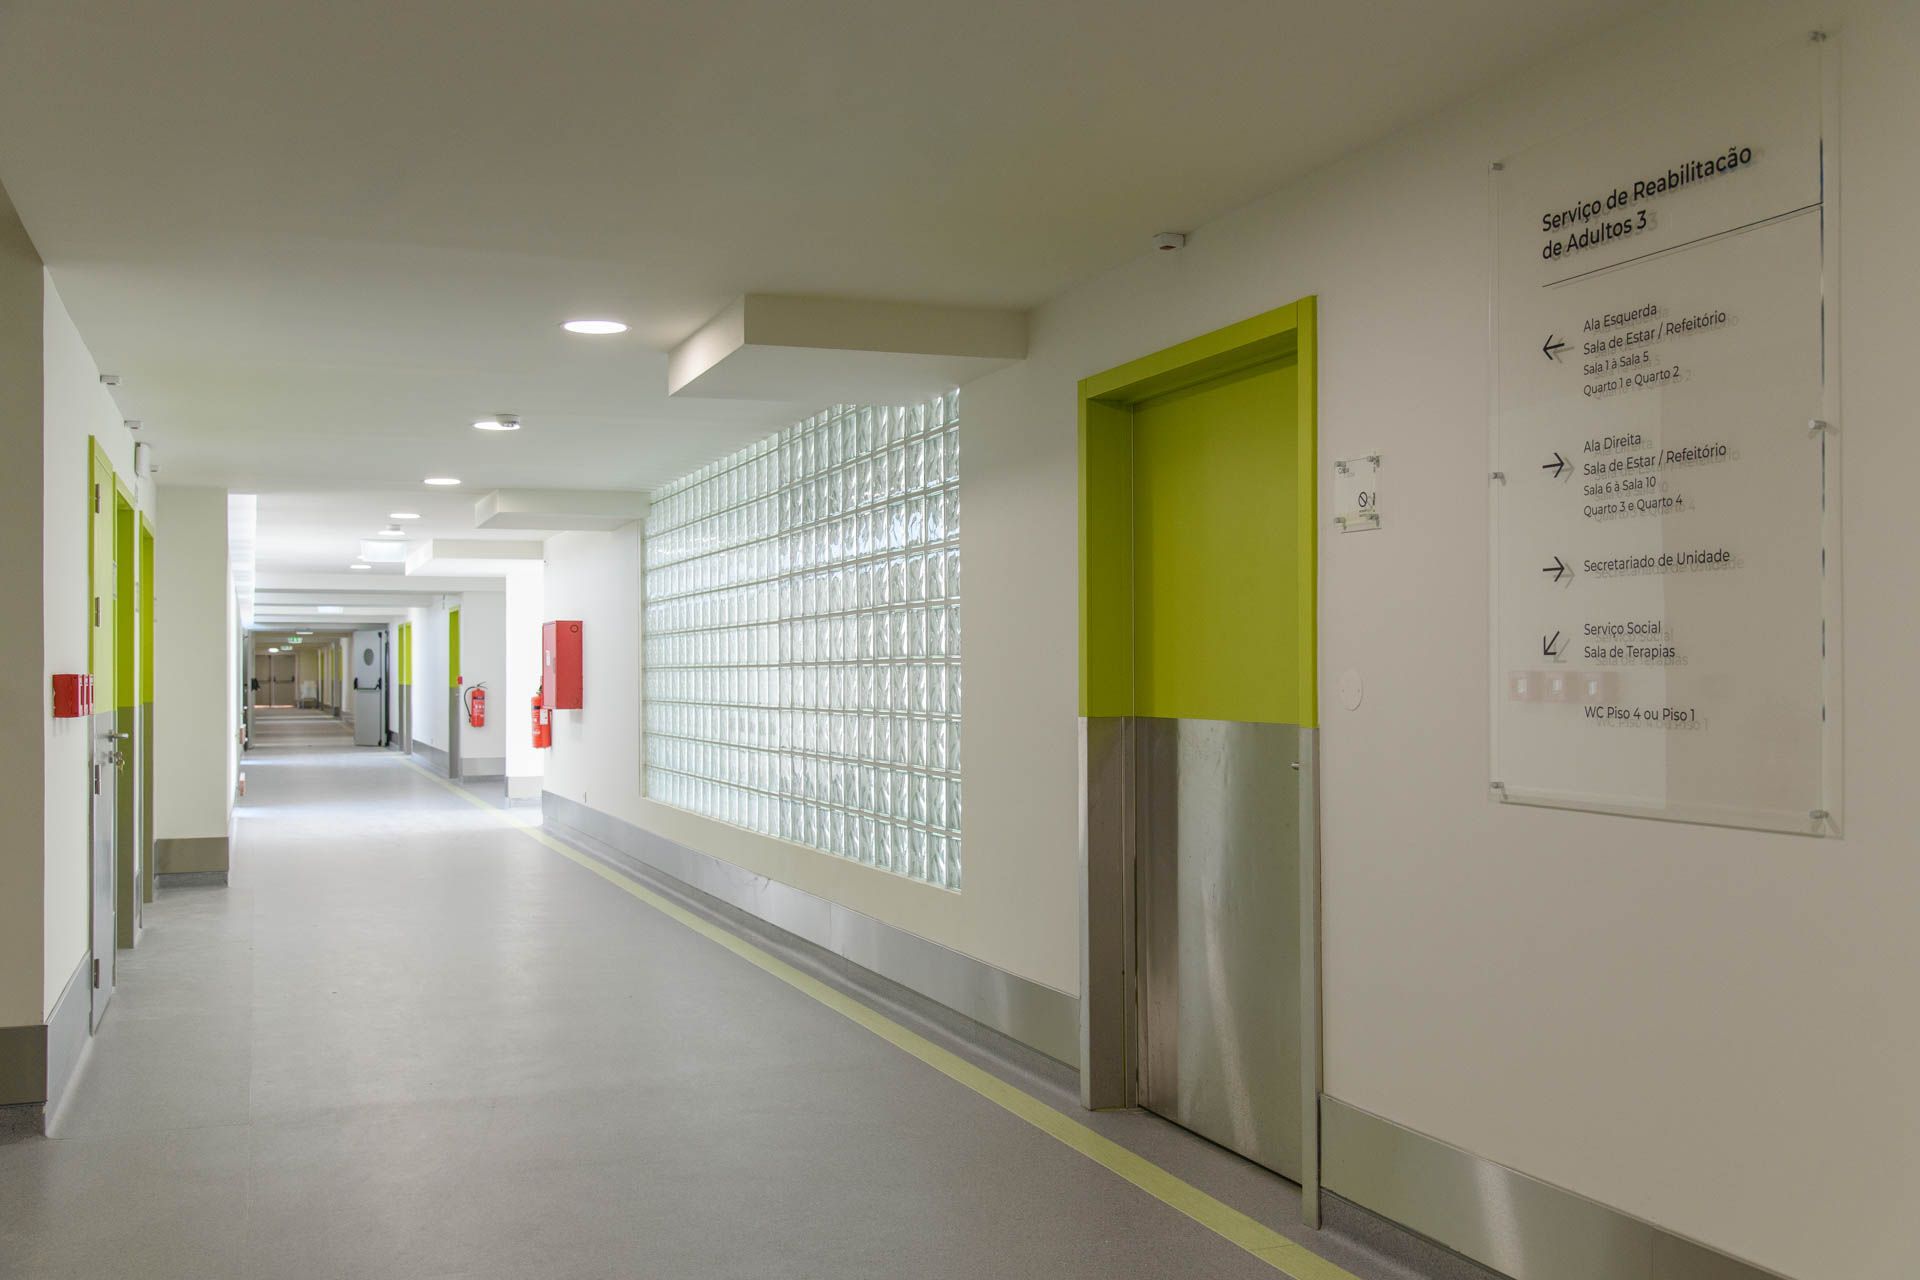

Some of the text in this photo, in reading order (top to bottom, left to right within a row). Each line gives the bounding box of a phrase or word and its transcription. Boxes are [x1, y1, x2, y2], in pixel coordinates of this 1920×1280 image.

[1542, 200, 1601, 232] Serviço
[1606, 189, 1628, 209] de
[1542, 209, 1648, 260] de Adultos 3
[1583, 303, 1657, 333] Ala Esquerda
[1583, 309, 1726, 356] Sala de Estar / Refeitório
[1583, 362, 1603, 376] Sala
[1605, 360, 1609, 371] 1
[1619, 353, 1640, 368] Sala
[1643, 351, 1649, 363] 5
[1583, 365, 1680, 397] Quarto 1 e Quarto 2
[1583, 433, 1642, 454] Ala Direita
[1583, 442, 1727, 476] Sala de Estar / Refeitório
[1583, 483, 1603, 497] Sala
[1605, 482, 1612, 494] 6
[1622, 477, 1643, 491] Sala
[1646, 476, 1657, 489] 10
[1583, 494, 1683, 518] Quarto 3 e Quarto 4
[1584, 548, 1731, 572] Secretariado de Unidade
[1584, 621, 1661, 639] Serviço Social
[1584, 644, 1676, 661] Sala de Terapias
[1584, 706, 1695, 721] WC Piso 4 ou Piso 1
